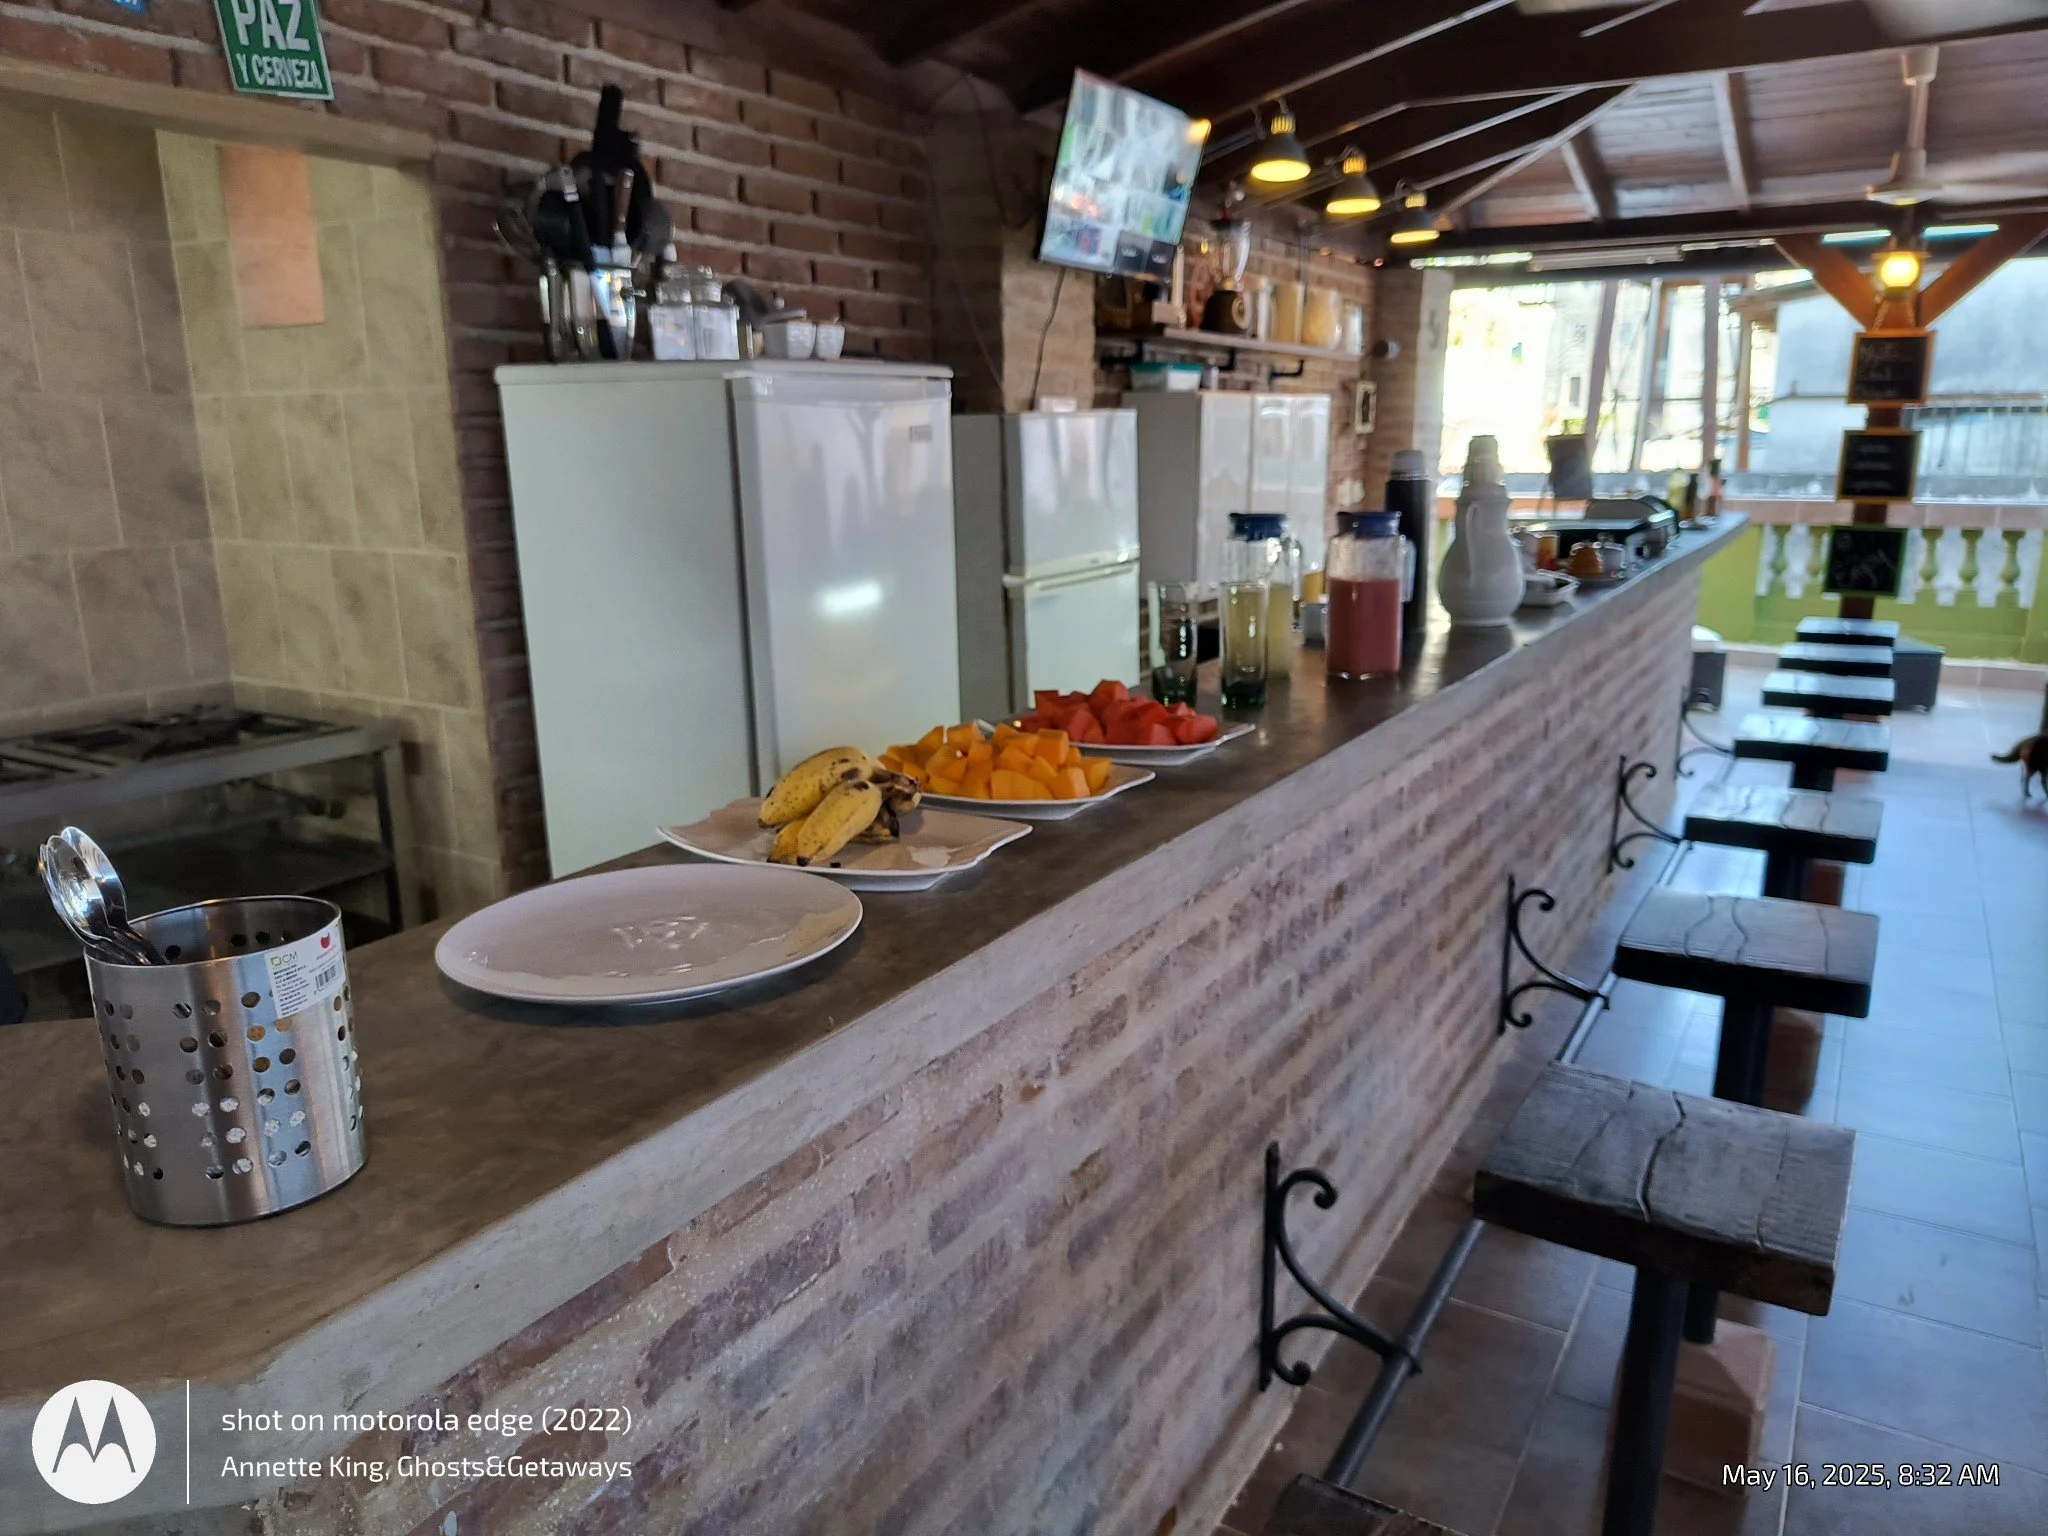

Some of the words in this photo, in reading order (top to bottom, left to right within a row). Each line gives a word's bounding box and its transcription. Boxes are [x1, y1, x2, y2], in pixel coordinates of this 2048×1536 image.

[232, 0, 311, 52] PAZ
[236, 53, 249, 84] Y
[252, 54, 323, 89] CERVEZA
